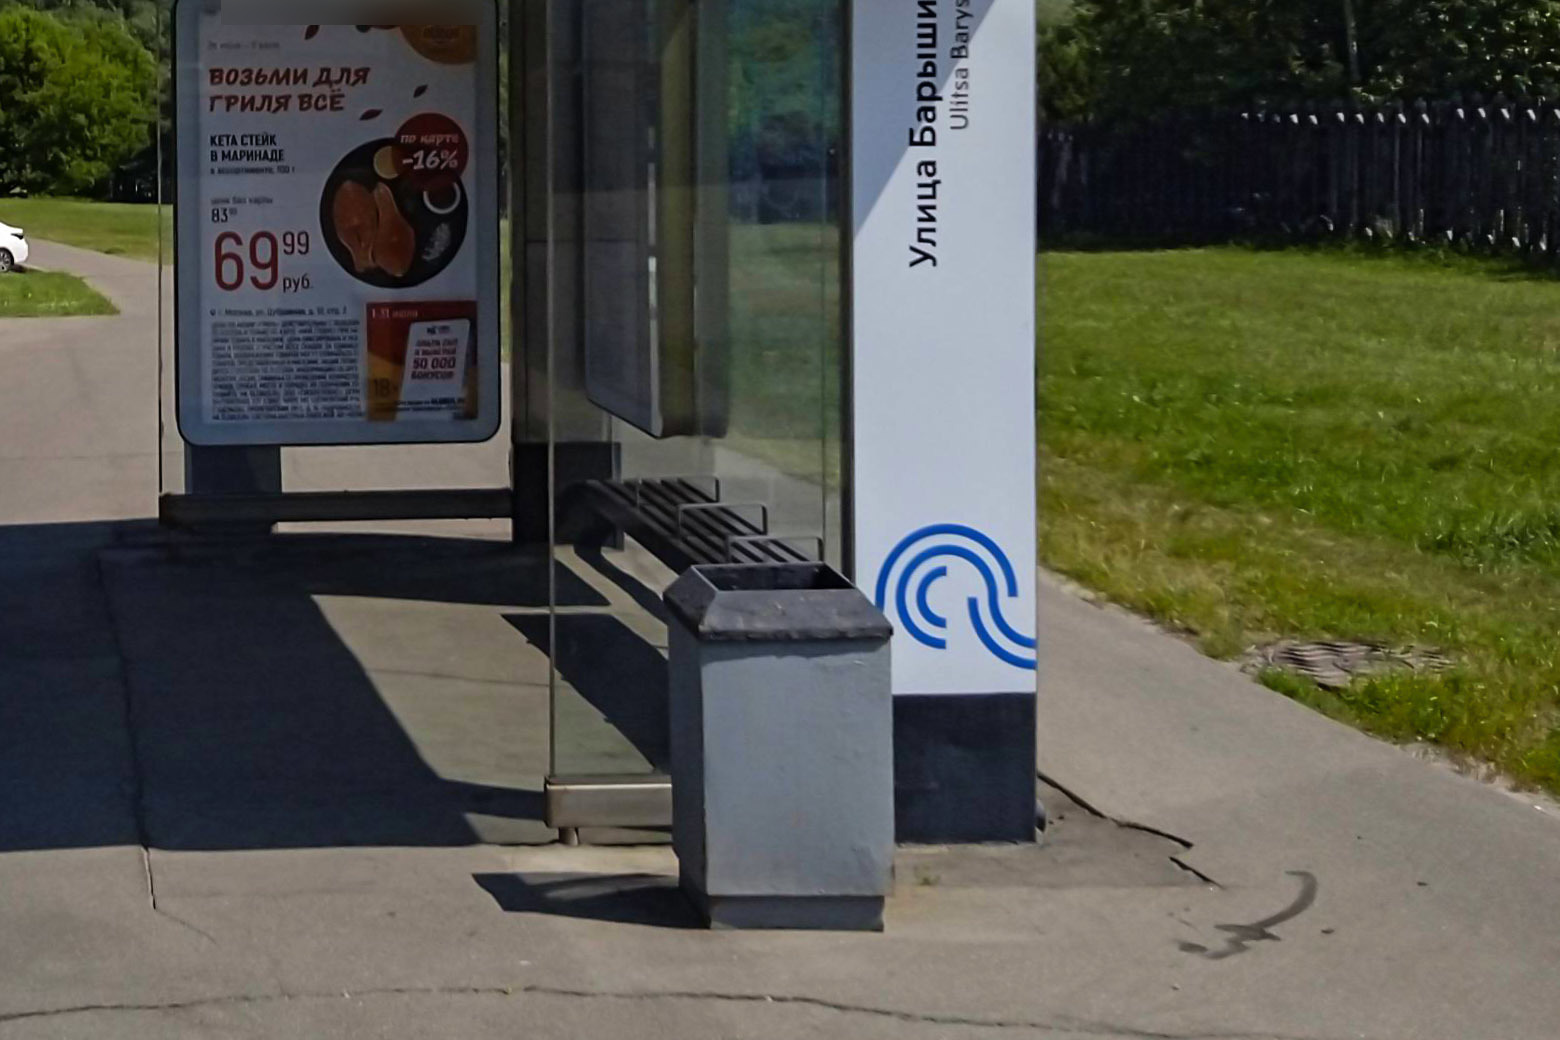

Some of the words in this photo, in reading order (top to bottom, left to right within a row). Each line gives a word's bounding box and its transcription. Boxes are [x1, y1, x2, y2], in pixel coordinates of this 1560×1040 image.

[209, 67, 308, 86] ВОЗЬМИ
[313, 67, 371, 87] ДЛЯ
[209, 94, 292, 113] ГРИЛЯ
[298, 88, 346, 111] ВСЁ
[949, 67, 969, 130] Ulitsa
[210, 134, 238, 147] КЕТА
[241, 131, 277, 147] СТЕЙК
[401, 135, 417, 144] по
[421, 134, 459, 147] карте
[210, 150, 218, 162] В
[221, 149, 284, 163] МАРИНАДЕ
[402, 150, 459, 170] -16%
[211, 208, 228, 222] 83
[909, 160, 941, 267] Улица
[214, 231, 278, 291] 69
[283, 231, 310, 255] 99
